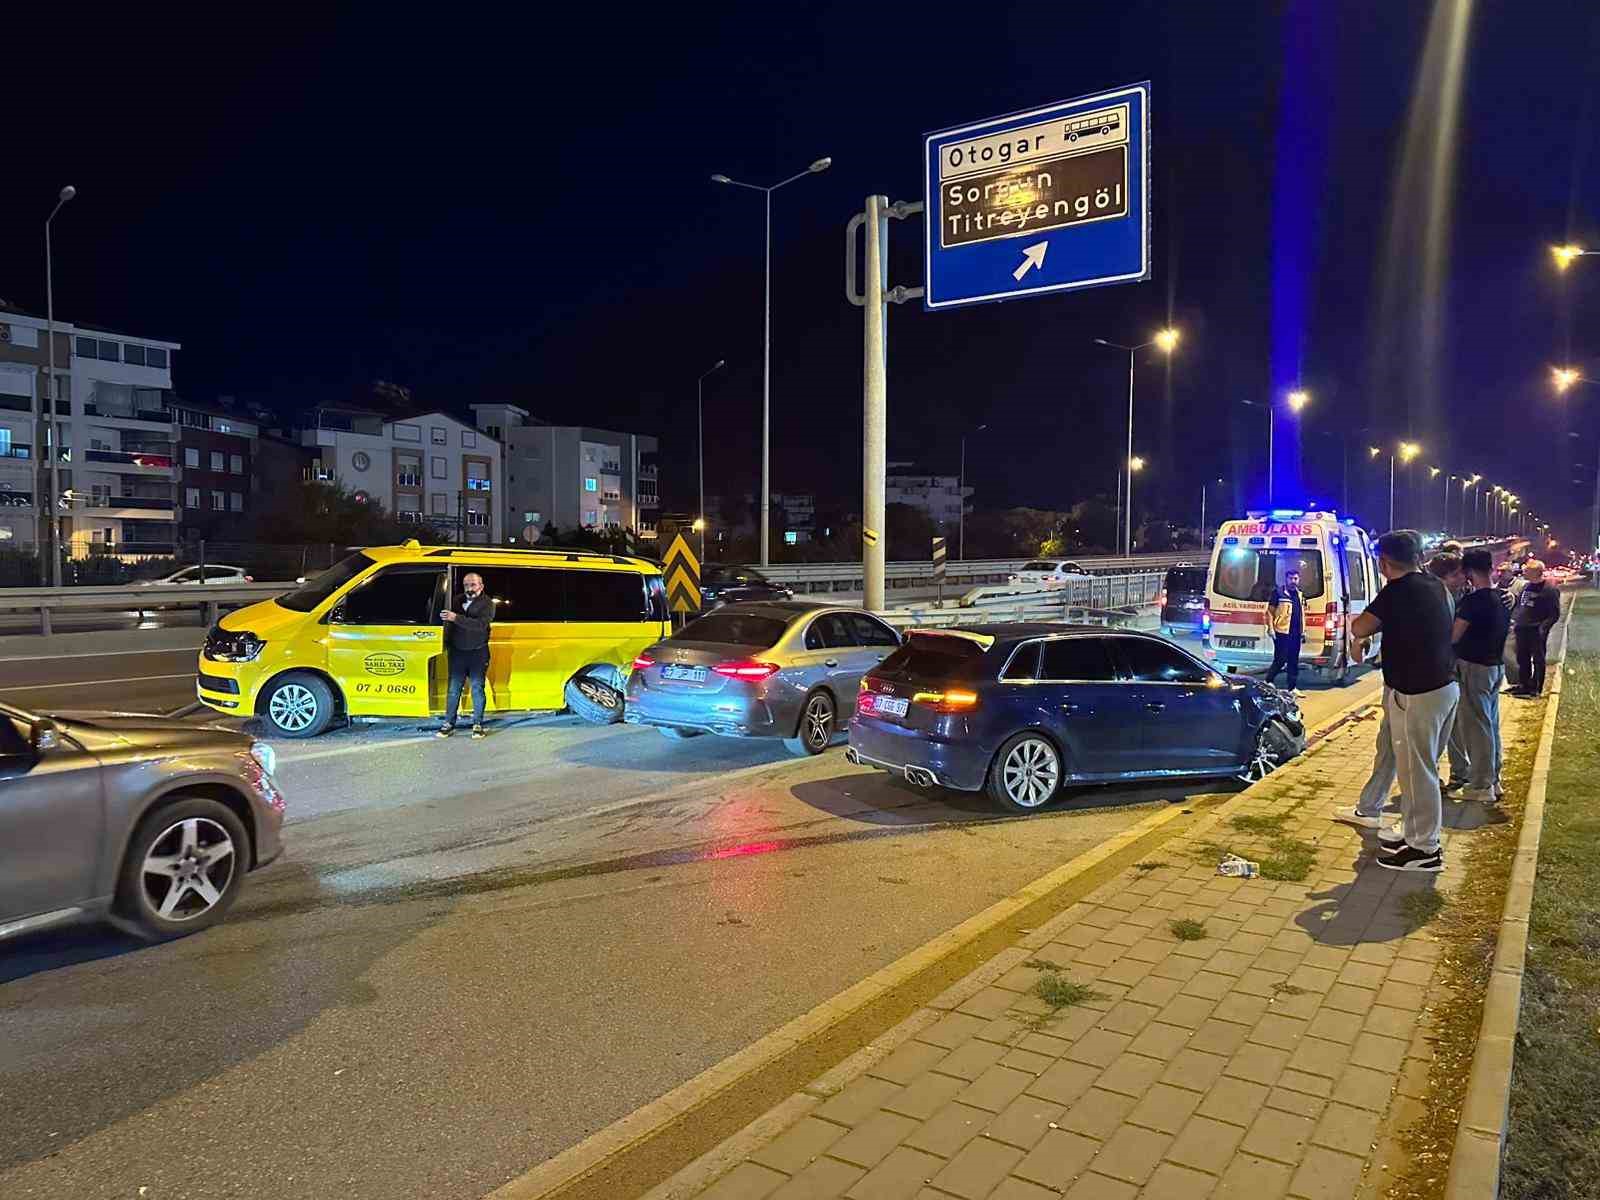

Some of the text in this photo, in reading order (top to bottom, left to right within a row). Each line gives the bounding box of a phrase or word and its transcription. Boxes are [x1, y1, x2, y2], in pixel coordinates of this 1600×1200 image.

[949, 134, 1045, 168] Otogar
[949, 184, 1121, 235] Titreyengöl
[1227, 523, 1313, 536] AMBULANS
[356, 683, 416, 694] 07 J 0680
